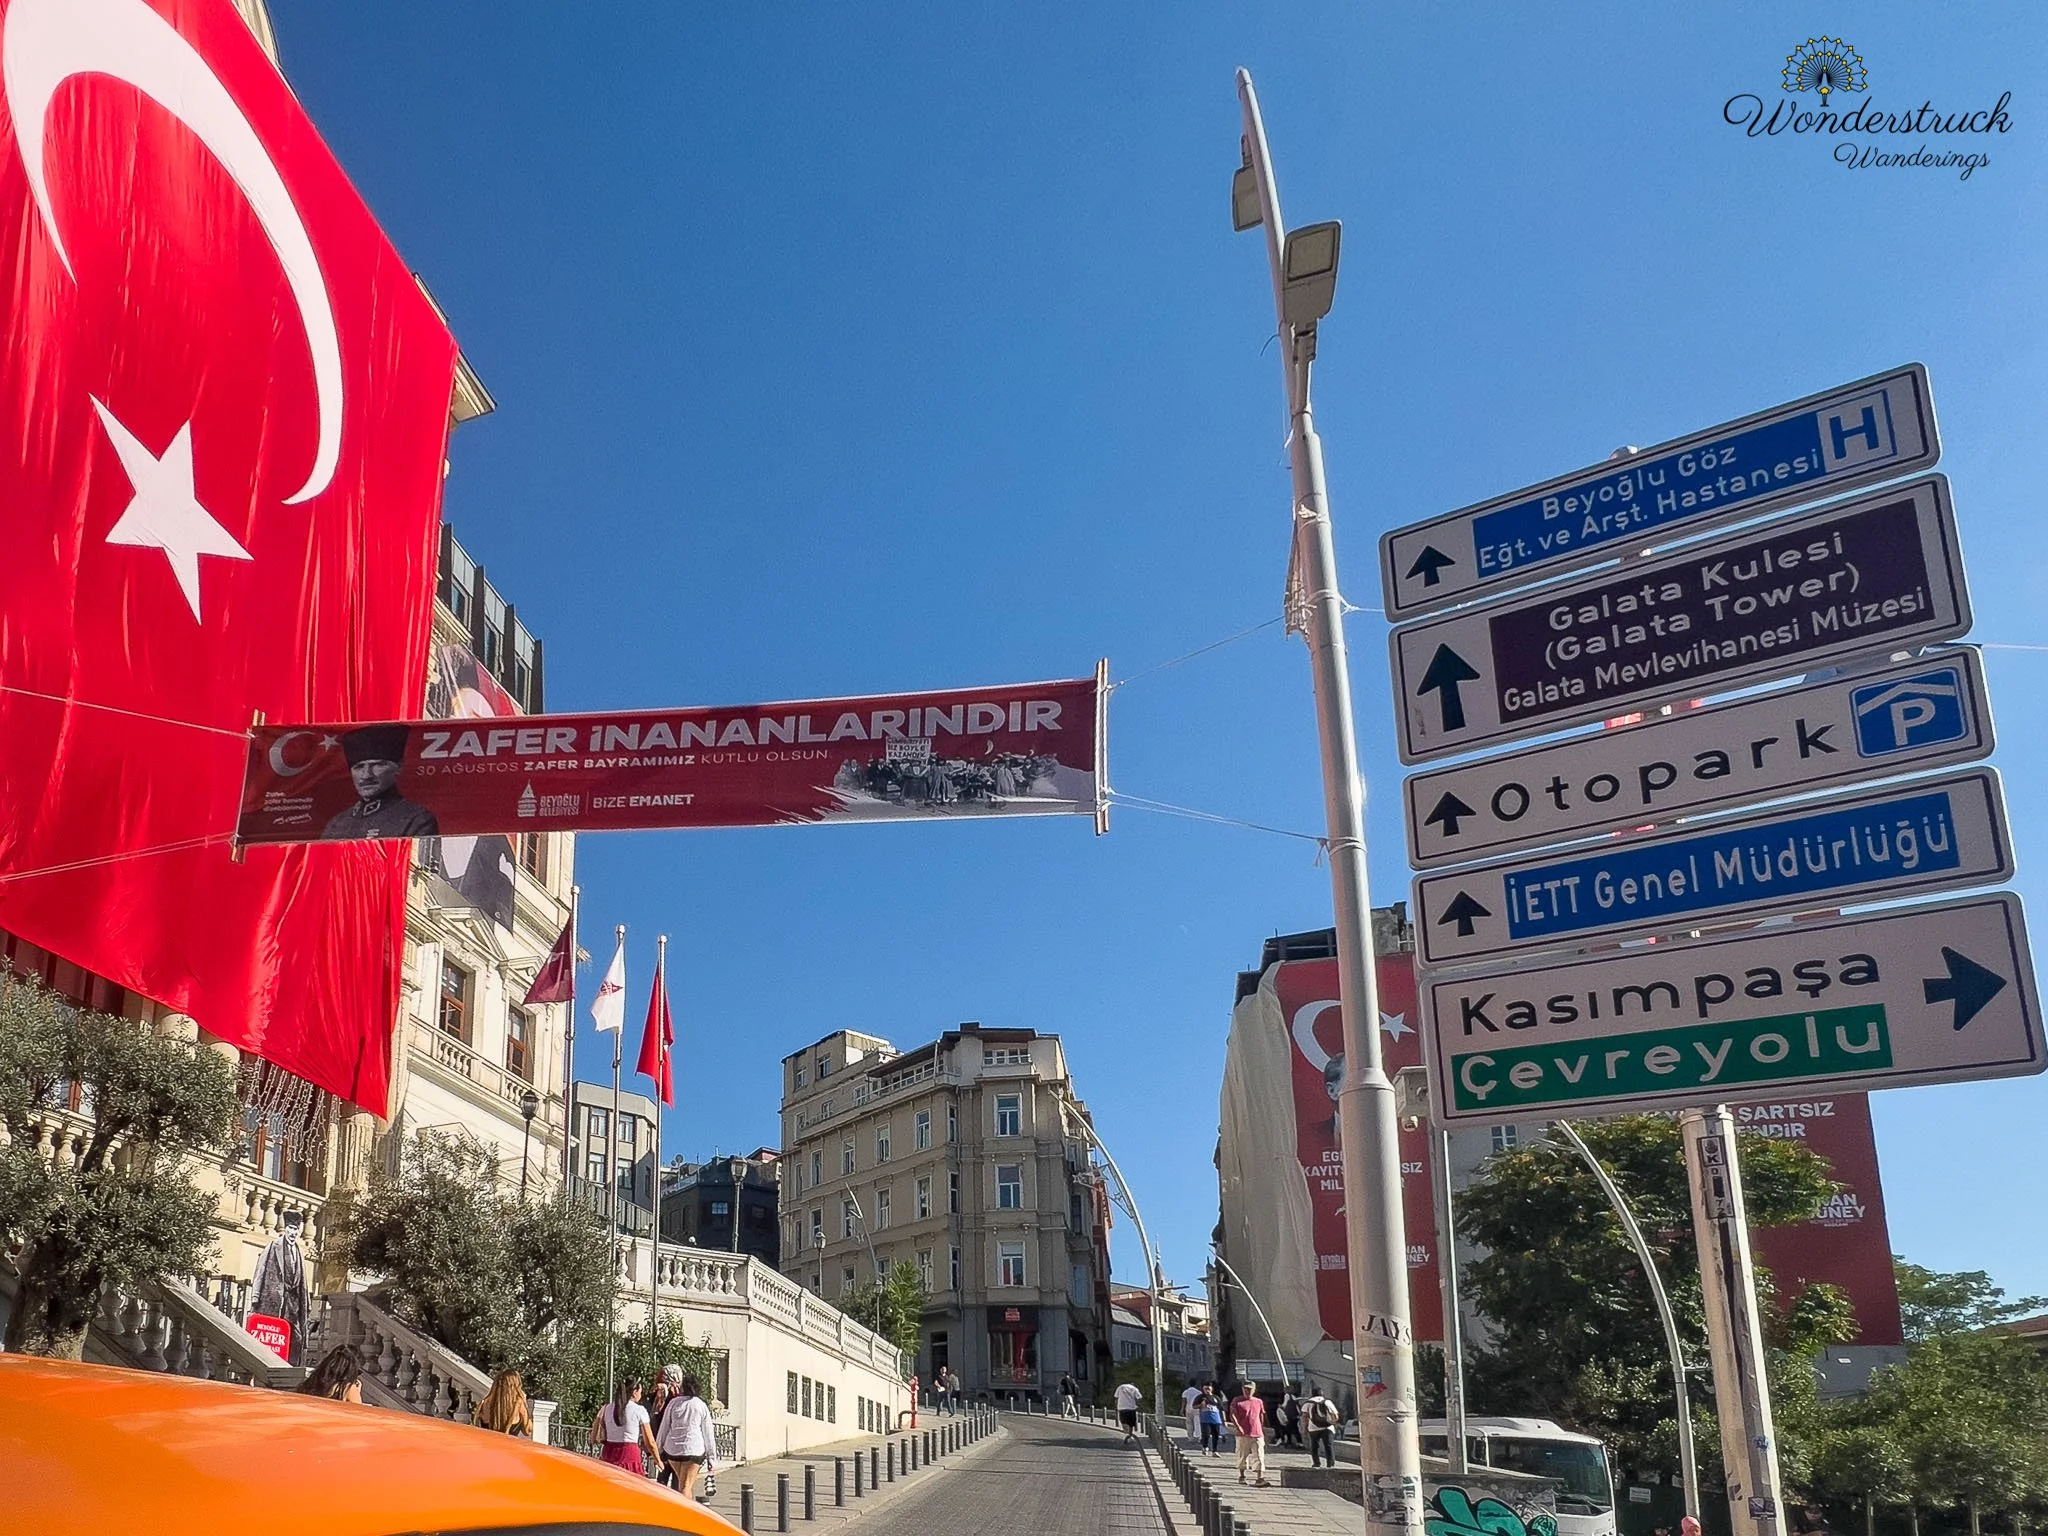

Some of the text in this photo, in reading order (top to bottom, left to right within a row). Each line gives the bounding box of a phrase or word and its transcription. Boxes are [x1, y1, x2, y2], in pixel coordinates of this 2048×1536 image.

[1480, 448, 1821, 571] Eğt. ve Arşt. Hastanesi
[1542, 445, 1737, 520] Beyoğlu Göz
[1544, 563, 1860, 671] (Galata Tower)
[1548, 531, 1844, 632] Galata Kulesi
[1503, 587, 1926, 713] Galata Mevlevihanesi Müzesi
[416, 749, 829, 777] 30 AĞUSTOS ZAFER BAYRAMIMIZ KUTLU OLSUN
[420, 700, 1063, 759] ZAFER İNANANLARINDIR
[1490, 718, 1840, 823] Otopark
[629, 794, 695, 808] EMANET
[1509, 813, 1951, 925] İETT Genel Müdürlüğü
[1460, 951, 1881, 1037] Kasımpaşa
[1460, 1016, 1882, 1101] Çevreyolu
[1738, 1102, 1835, 1122] ŞARTSIZ
[250, 1329, 286, 1346] ZAFER
